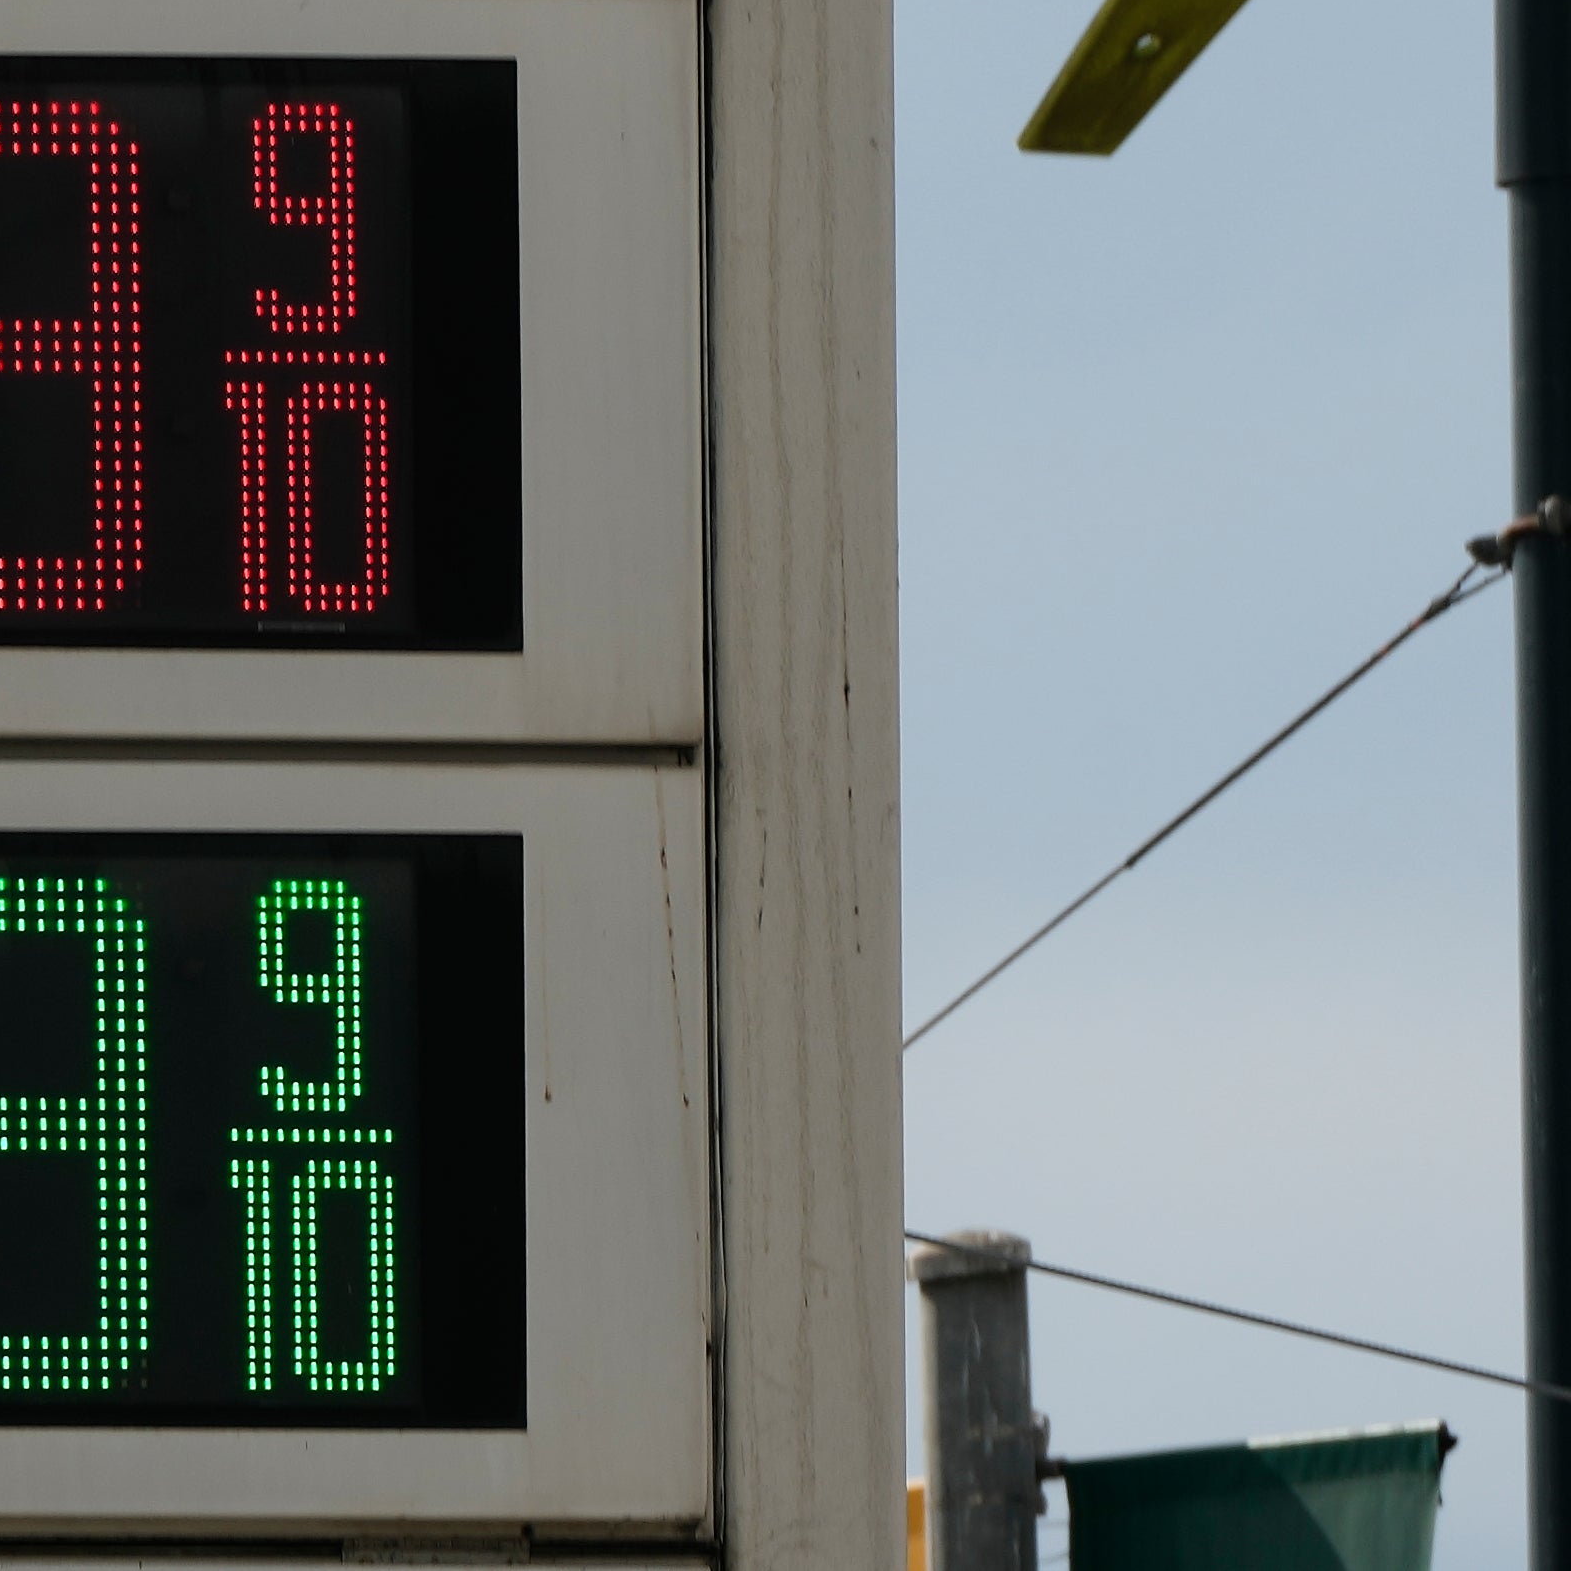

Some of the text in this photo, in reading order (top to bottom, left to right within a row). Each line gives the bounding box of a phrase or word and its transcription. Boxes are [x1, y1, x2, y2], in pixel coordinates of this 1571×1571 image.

[250, 101, 360, 335] 9
[222, 379, 392, 615] 10
[253, 877, 366, 1114] 9
[227, 1157, 399, 1395] 10
